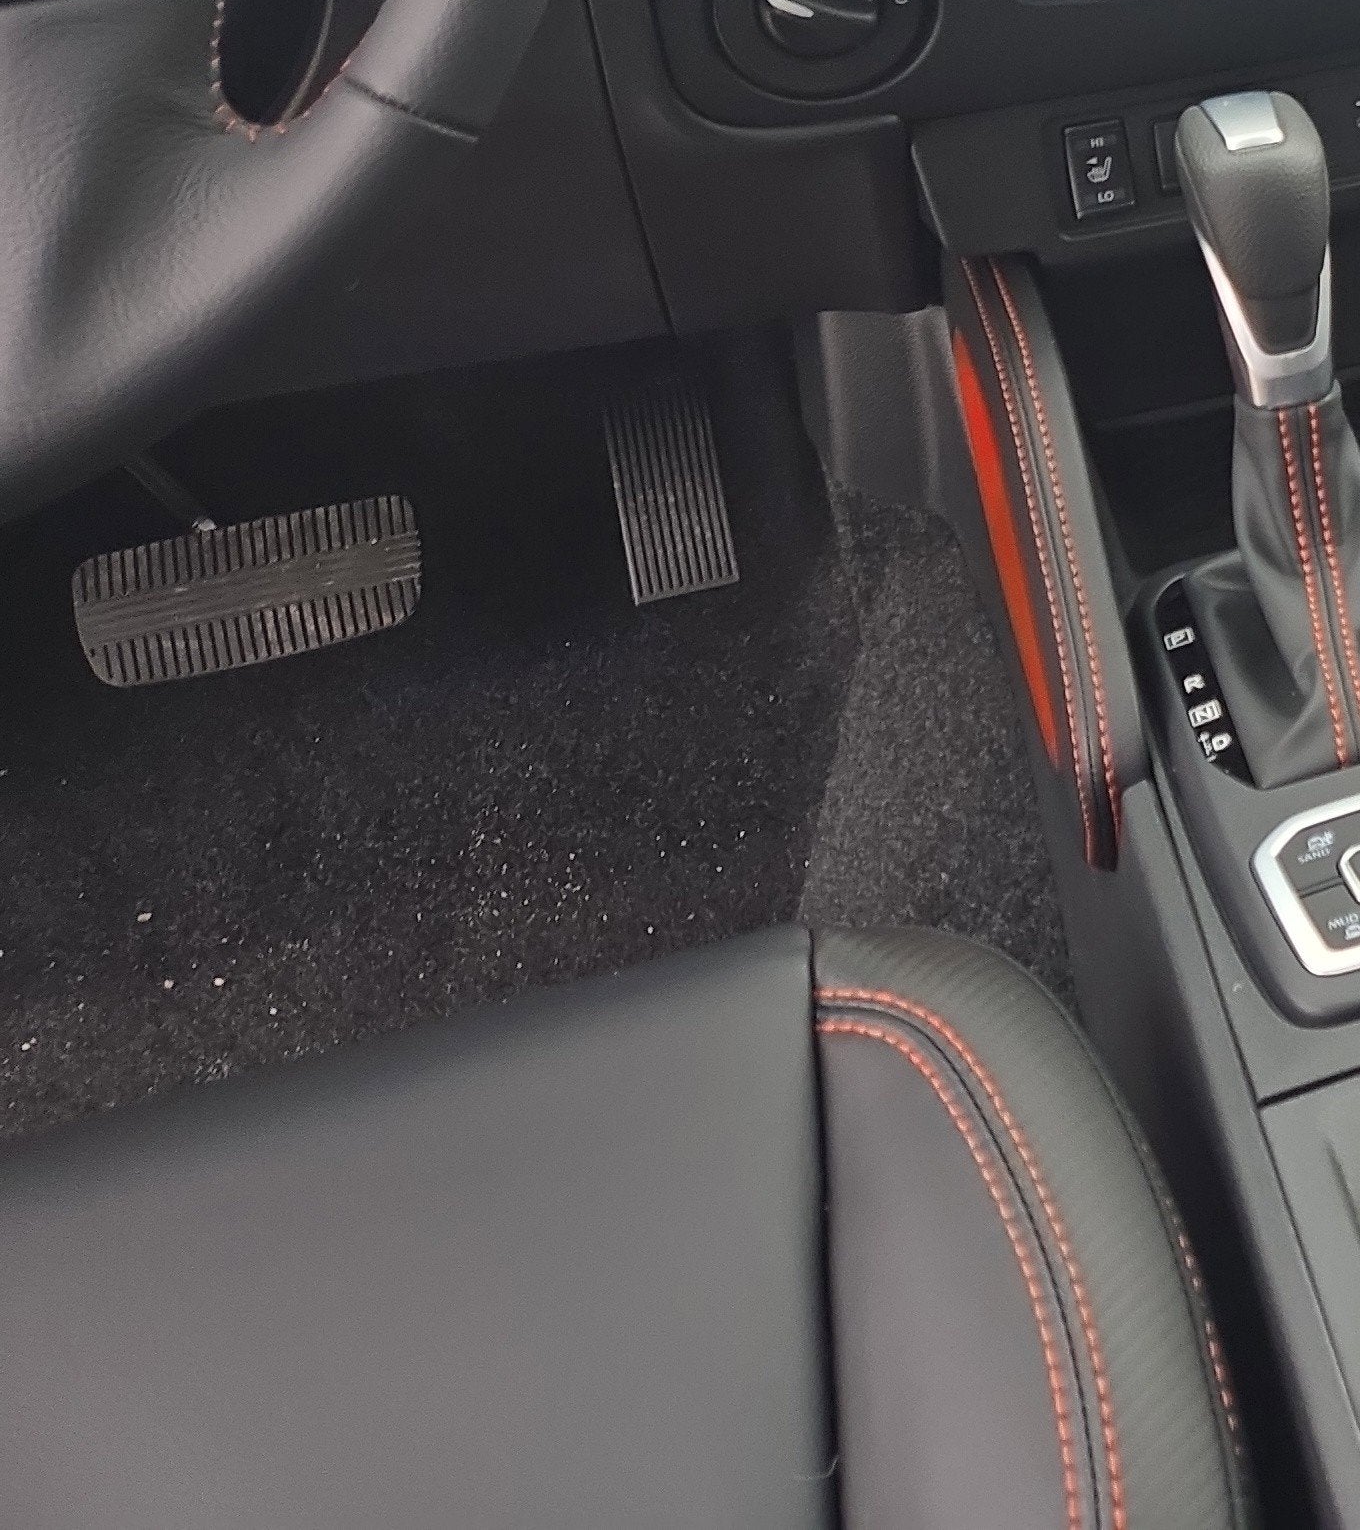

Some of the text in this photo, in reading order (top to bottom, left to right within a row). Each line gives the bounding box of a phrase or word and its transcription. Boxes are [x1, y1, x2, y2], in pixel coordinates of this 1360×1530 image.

[1183, 674, 1205, 694] R
[1297, 848, 1332, 866] SAND
[1326, 912, 1359, 931] MUD
